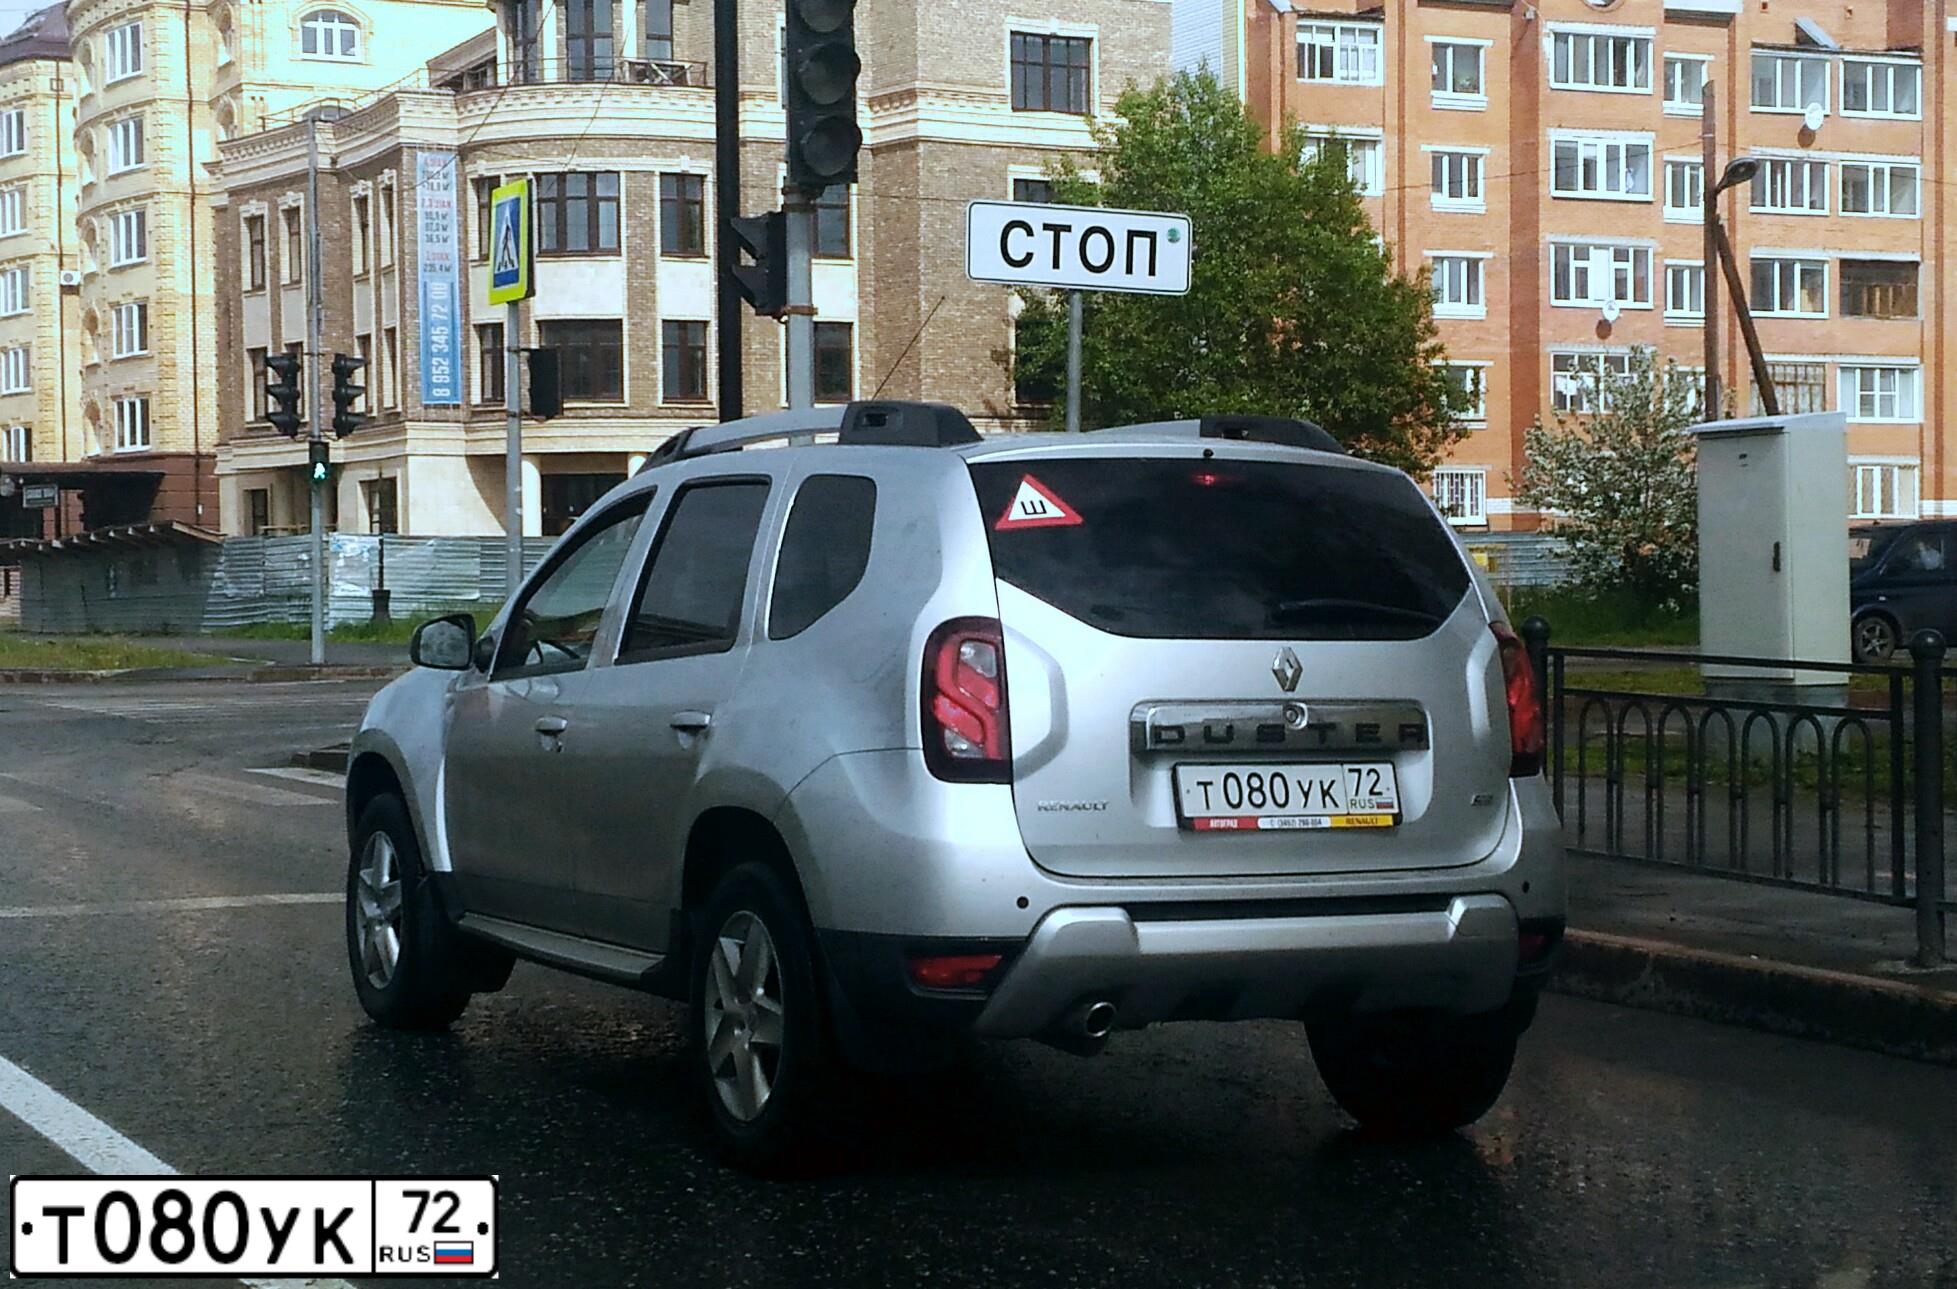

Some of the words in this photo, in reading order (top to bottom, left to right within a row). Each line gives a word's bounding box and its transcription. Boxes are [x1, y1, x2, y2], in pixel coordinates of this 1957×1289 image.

[1000, 219, 1157, 277] СТОП
[431, 304, 448, 321] 72
[431, 326, 449, 353] 345
[431, 357, 450, 384] 952
[432, 388, 451, 397] 8
[1020, 500, 1047, 515] Ш
[1154, 722, 1425, 745] DUSTER
[1196, 771, 1340, 810] Т080УК
[1348, 767, 1383, 796] 72
[1037, 801, 1109, 811] RENAULT
[1350, 799, 1376, 809] RUS
